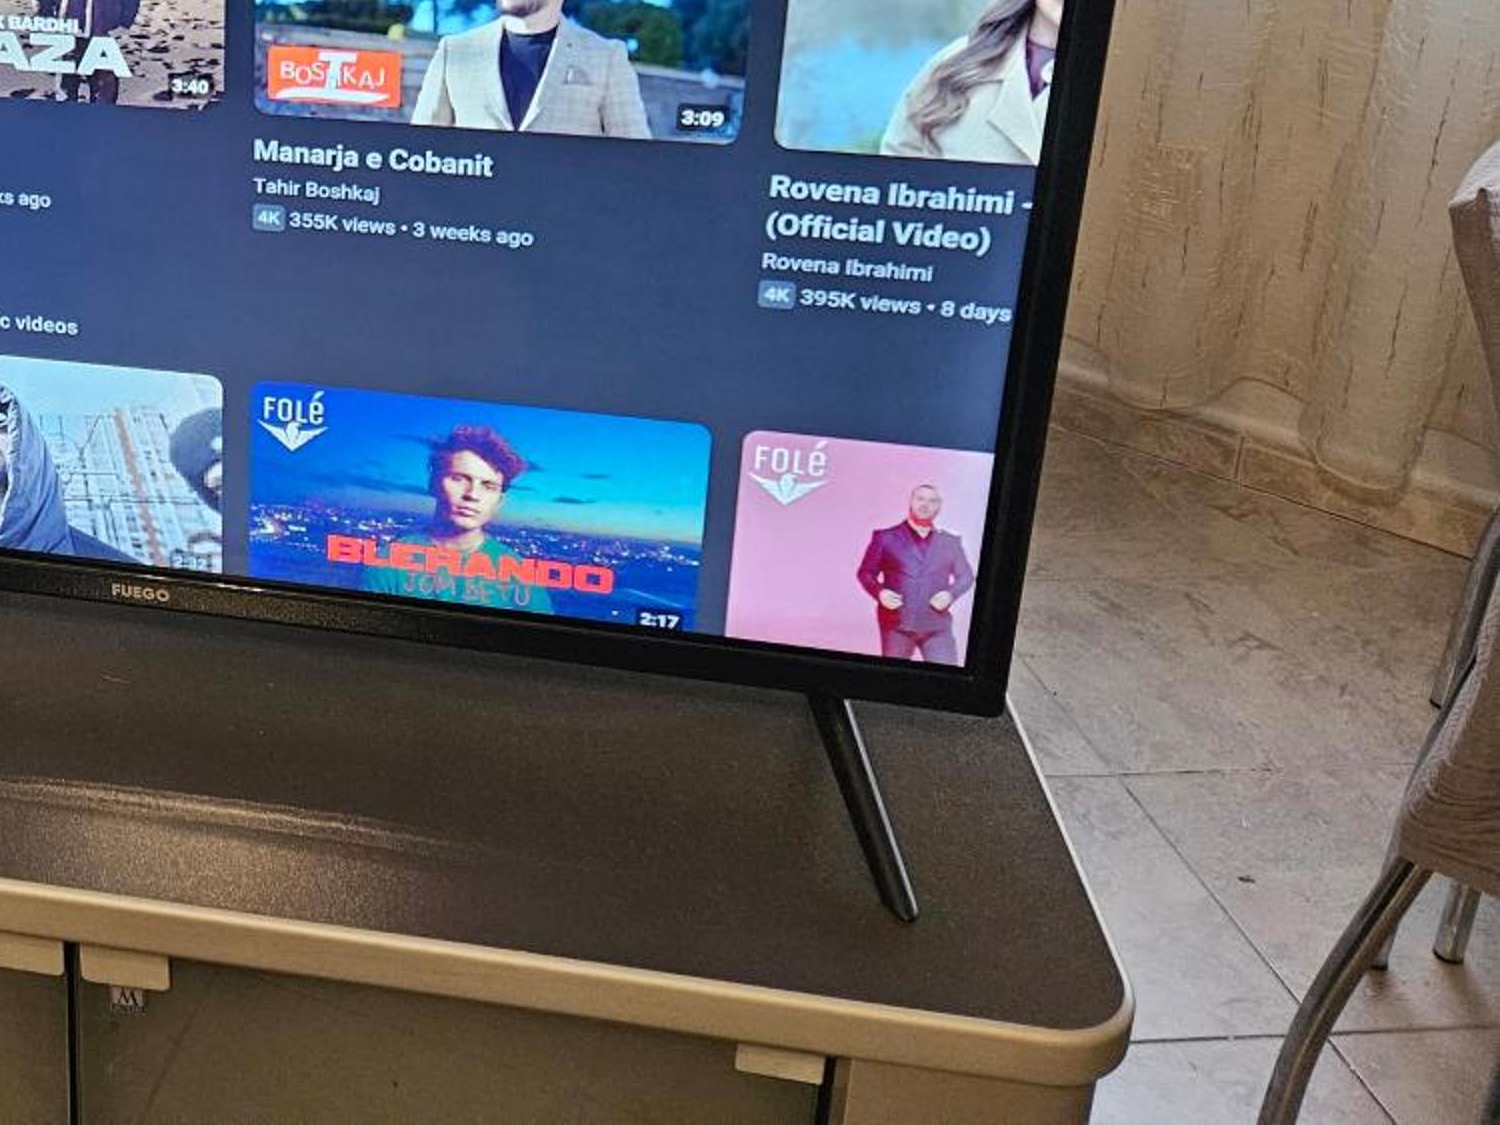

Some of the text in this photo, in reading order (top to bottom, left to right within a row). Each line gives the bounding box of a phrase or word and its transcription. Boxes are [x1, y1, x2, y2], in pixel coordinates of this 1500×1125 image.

[8, 16, 79, 34] BARDHI
[171, 79, 208, 94] 3:40
[681, 109, 725, 127] 3:09
[253, 139, 494, 177] Manarja e Cobanit
[18, 193, 51, 210] ago
[253, 177, 380, 205] Tahir Boshkaj
[769, 174, 880, 205] Rovena
[887, 183, 1015, 215] Ibrahimi
[258, 211, 534, 248] 4K 355K views 3 weeks ago
[765, 210, 991, 257] (Official Video)
[762, 253, 933, 282] Rovena Ibrahimi
[764, 288, 1013, 325] 4K 395K views 8 days
[16, 315, 79, 335] videos
[327, 534, 615, 594] BLERANDO
[111, 582, 170, 601] FUEGO
[640, 612, 680, 628] 2:17
